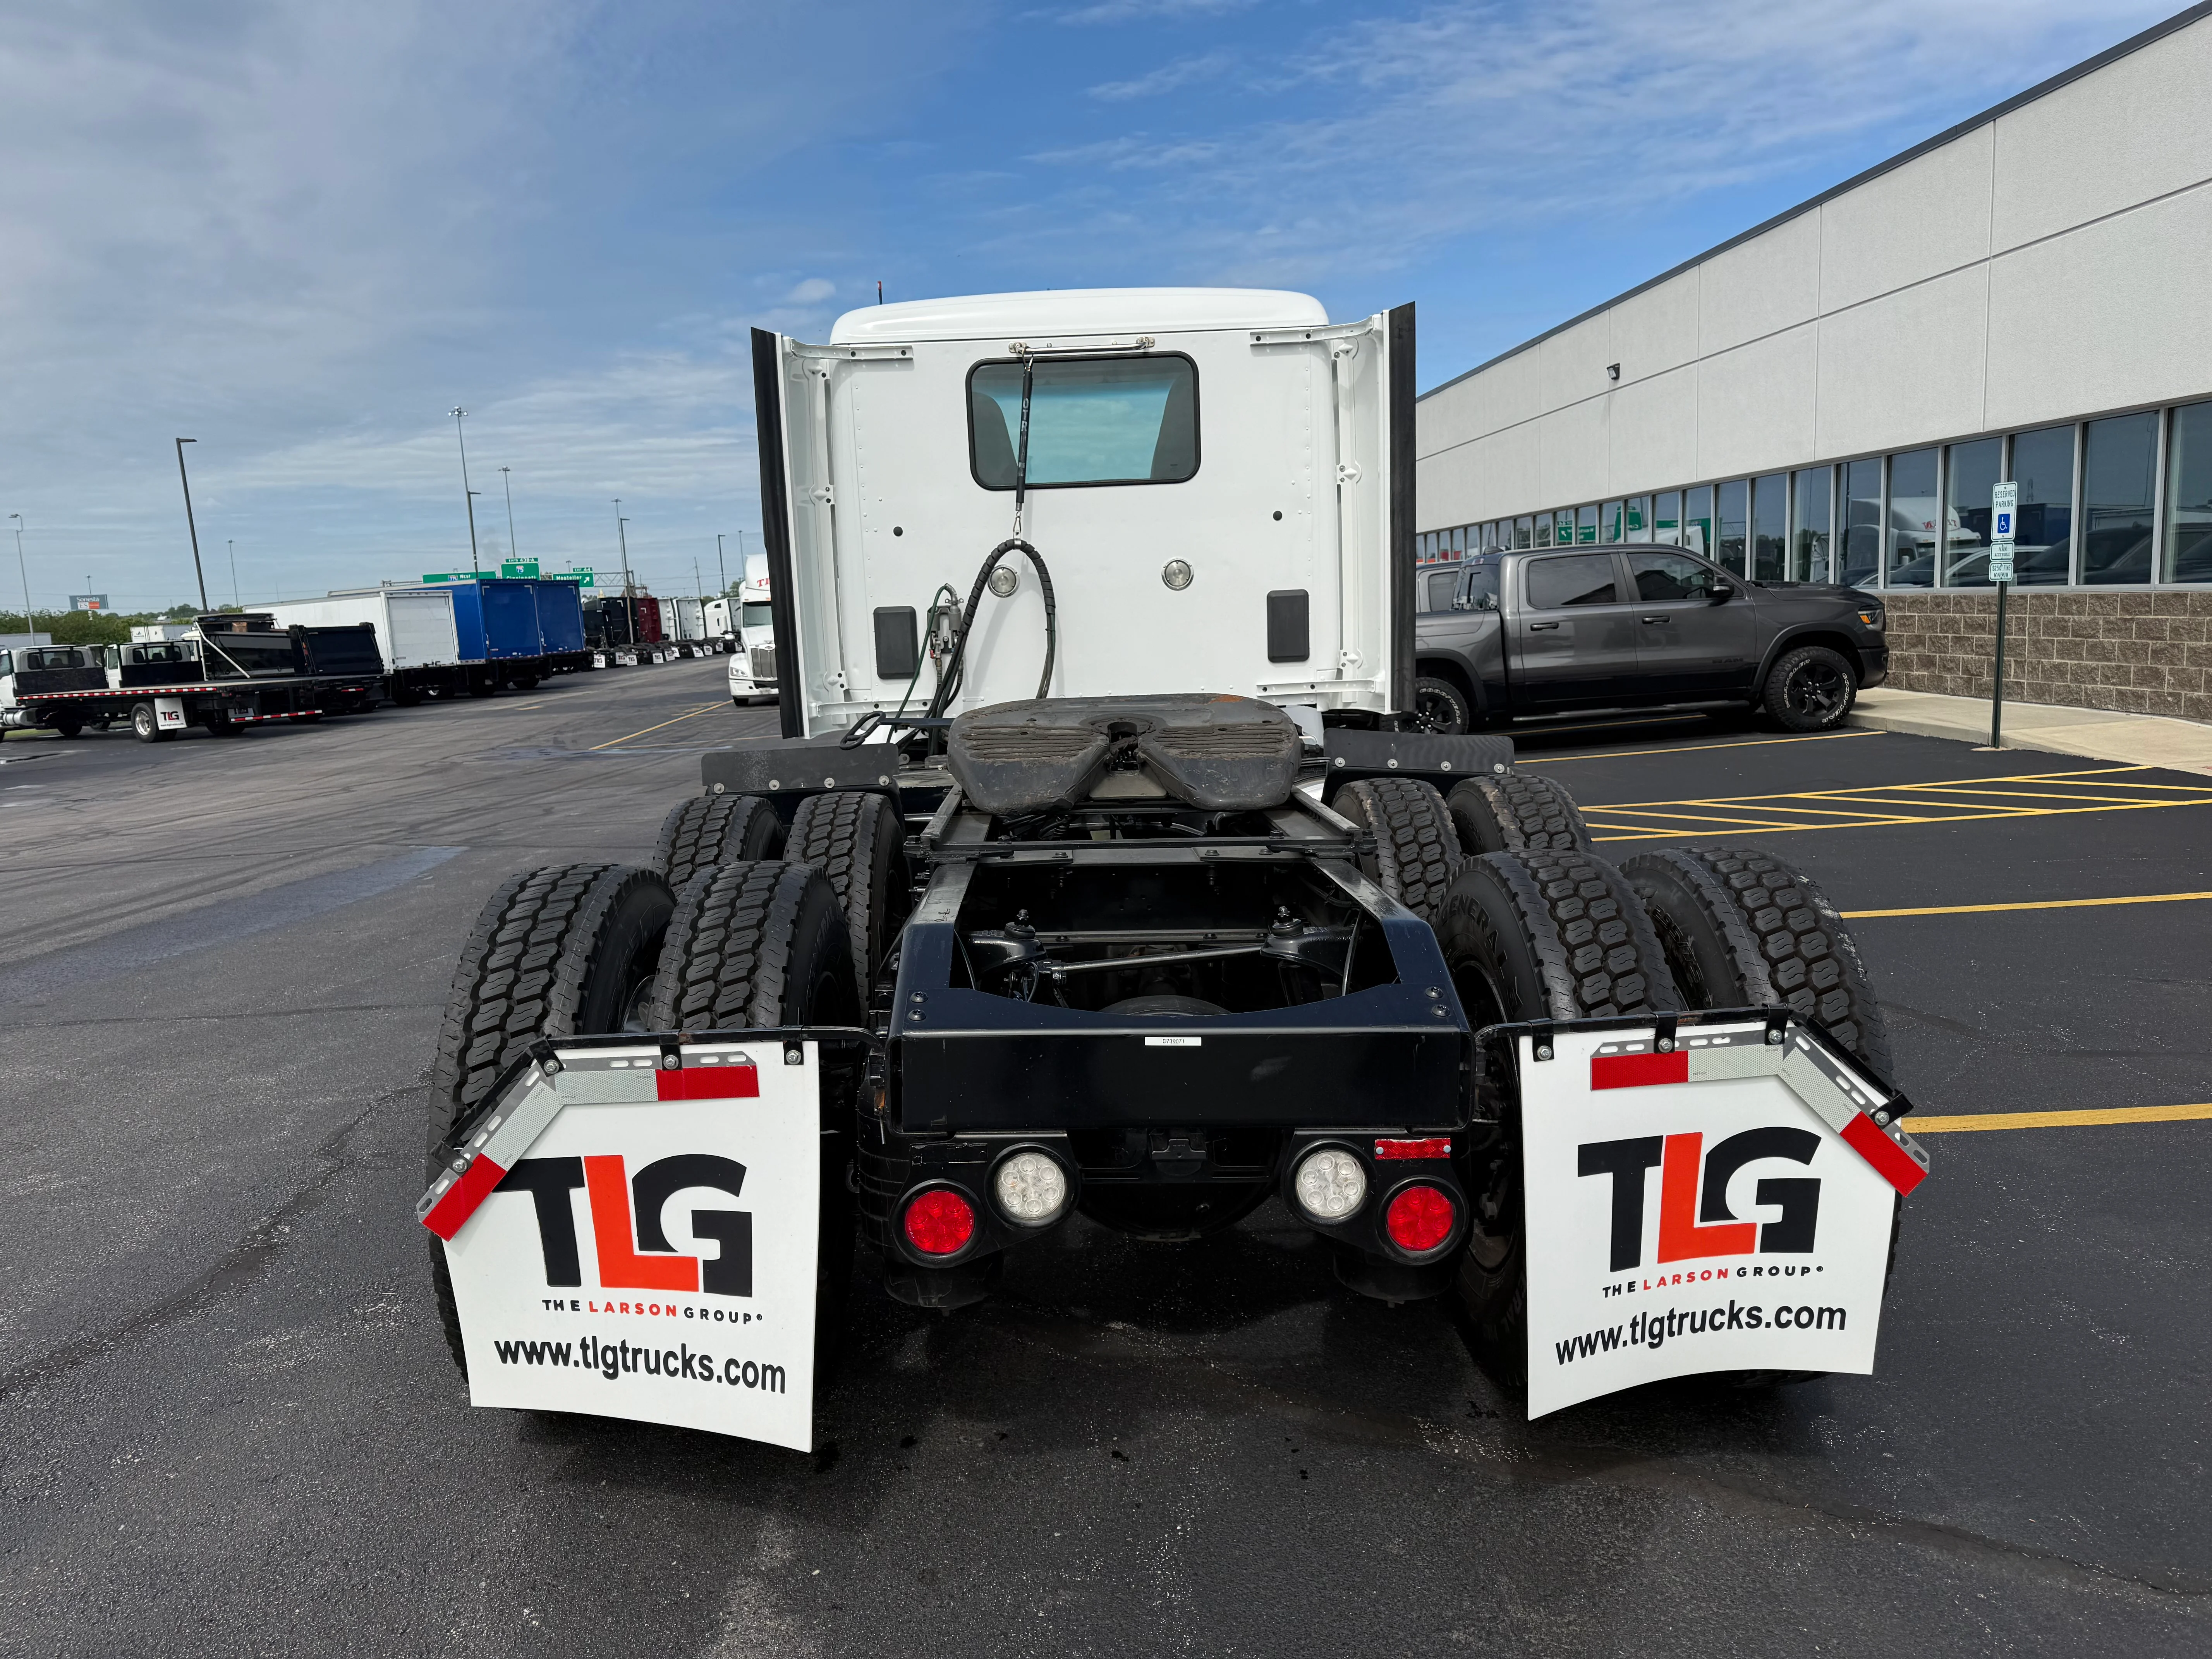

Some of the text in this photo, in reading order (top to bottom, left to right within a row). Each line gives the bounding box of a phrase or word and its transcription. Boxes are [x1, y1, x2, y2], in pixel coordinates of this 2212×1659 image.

[1995, 490, 2015, 498] RESERVED
[160, 711, 180, 721] TLG
[1419, 688, 1461, 725] GOODYEAR
[1822, 672, 1850, 723] GOODYEAR
[1578, 1127, 1822, 1273] TLG
[493, 1154, 753, 1298] TLG
[1602, 1281, 1636, 1298] THE
[1644, 1267, 1728, 1291] LARSON
[542, 1300, 580, 1312] THE
[589, 1300, 677, 1317] LARSON
[1555, 1299, 1847, 1365] www.tlgtrucks.com
[495, 1335, 786, 1394] www.tlgtrucks.com
